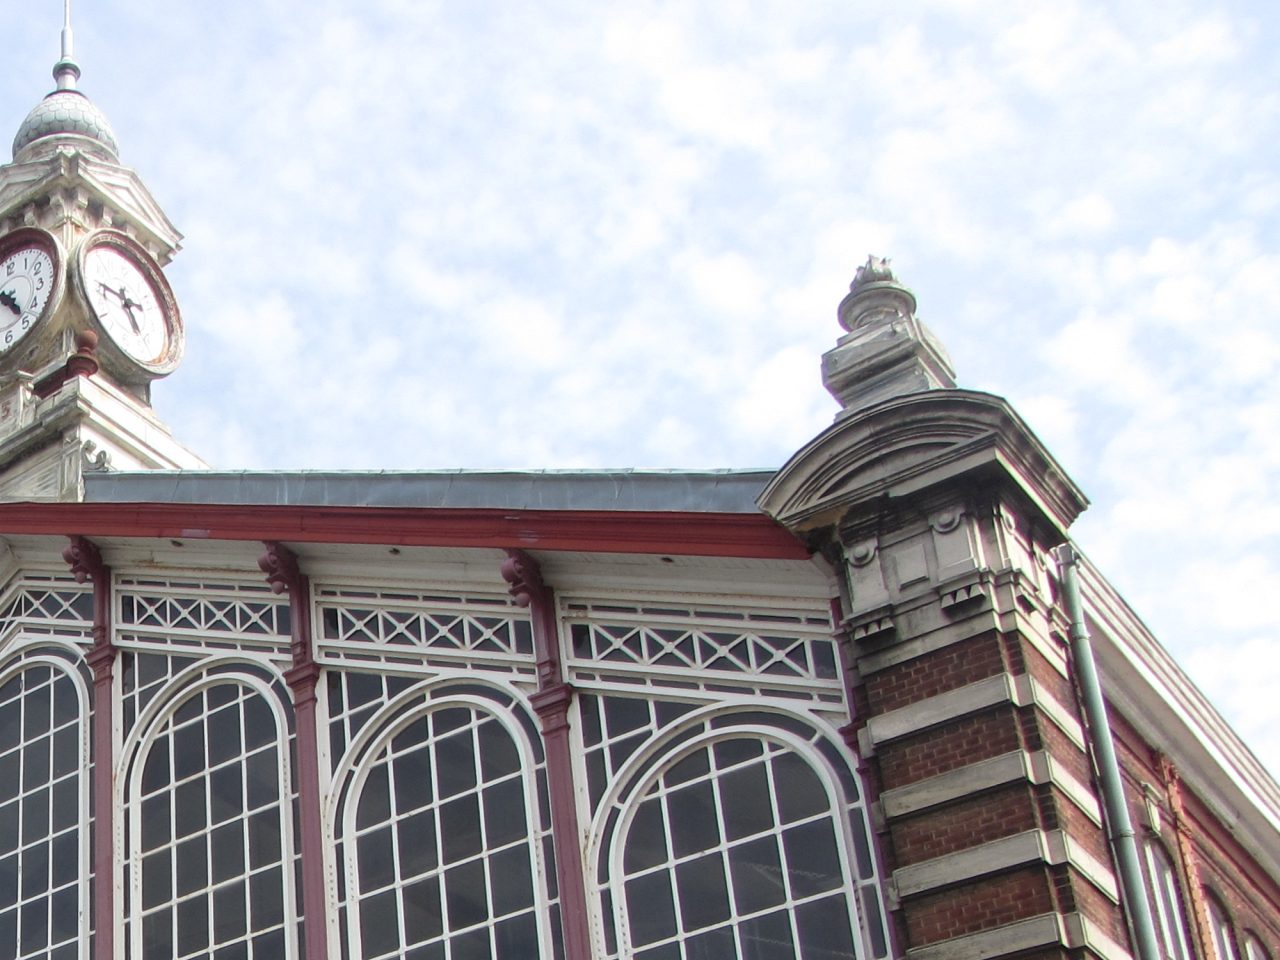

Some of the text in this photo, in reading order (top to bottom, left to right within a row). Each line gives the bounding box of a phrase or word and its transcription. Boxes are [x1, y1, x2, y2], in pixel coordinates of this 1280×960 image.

[6, 261, 15, 276] 12
[33, 262, 42, 276] 2
[36, 278, 44, 291] 3
[30, 296, 38, 309] 4
[22, 315, 30, 329] 5
[5, 330, 13, 343] 6
